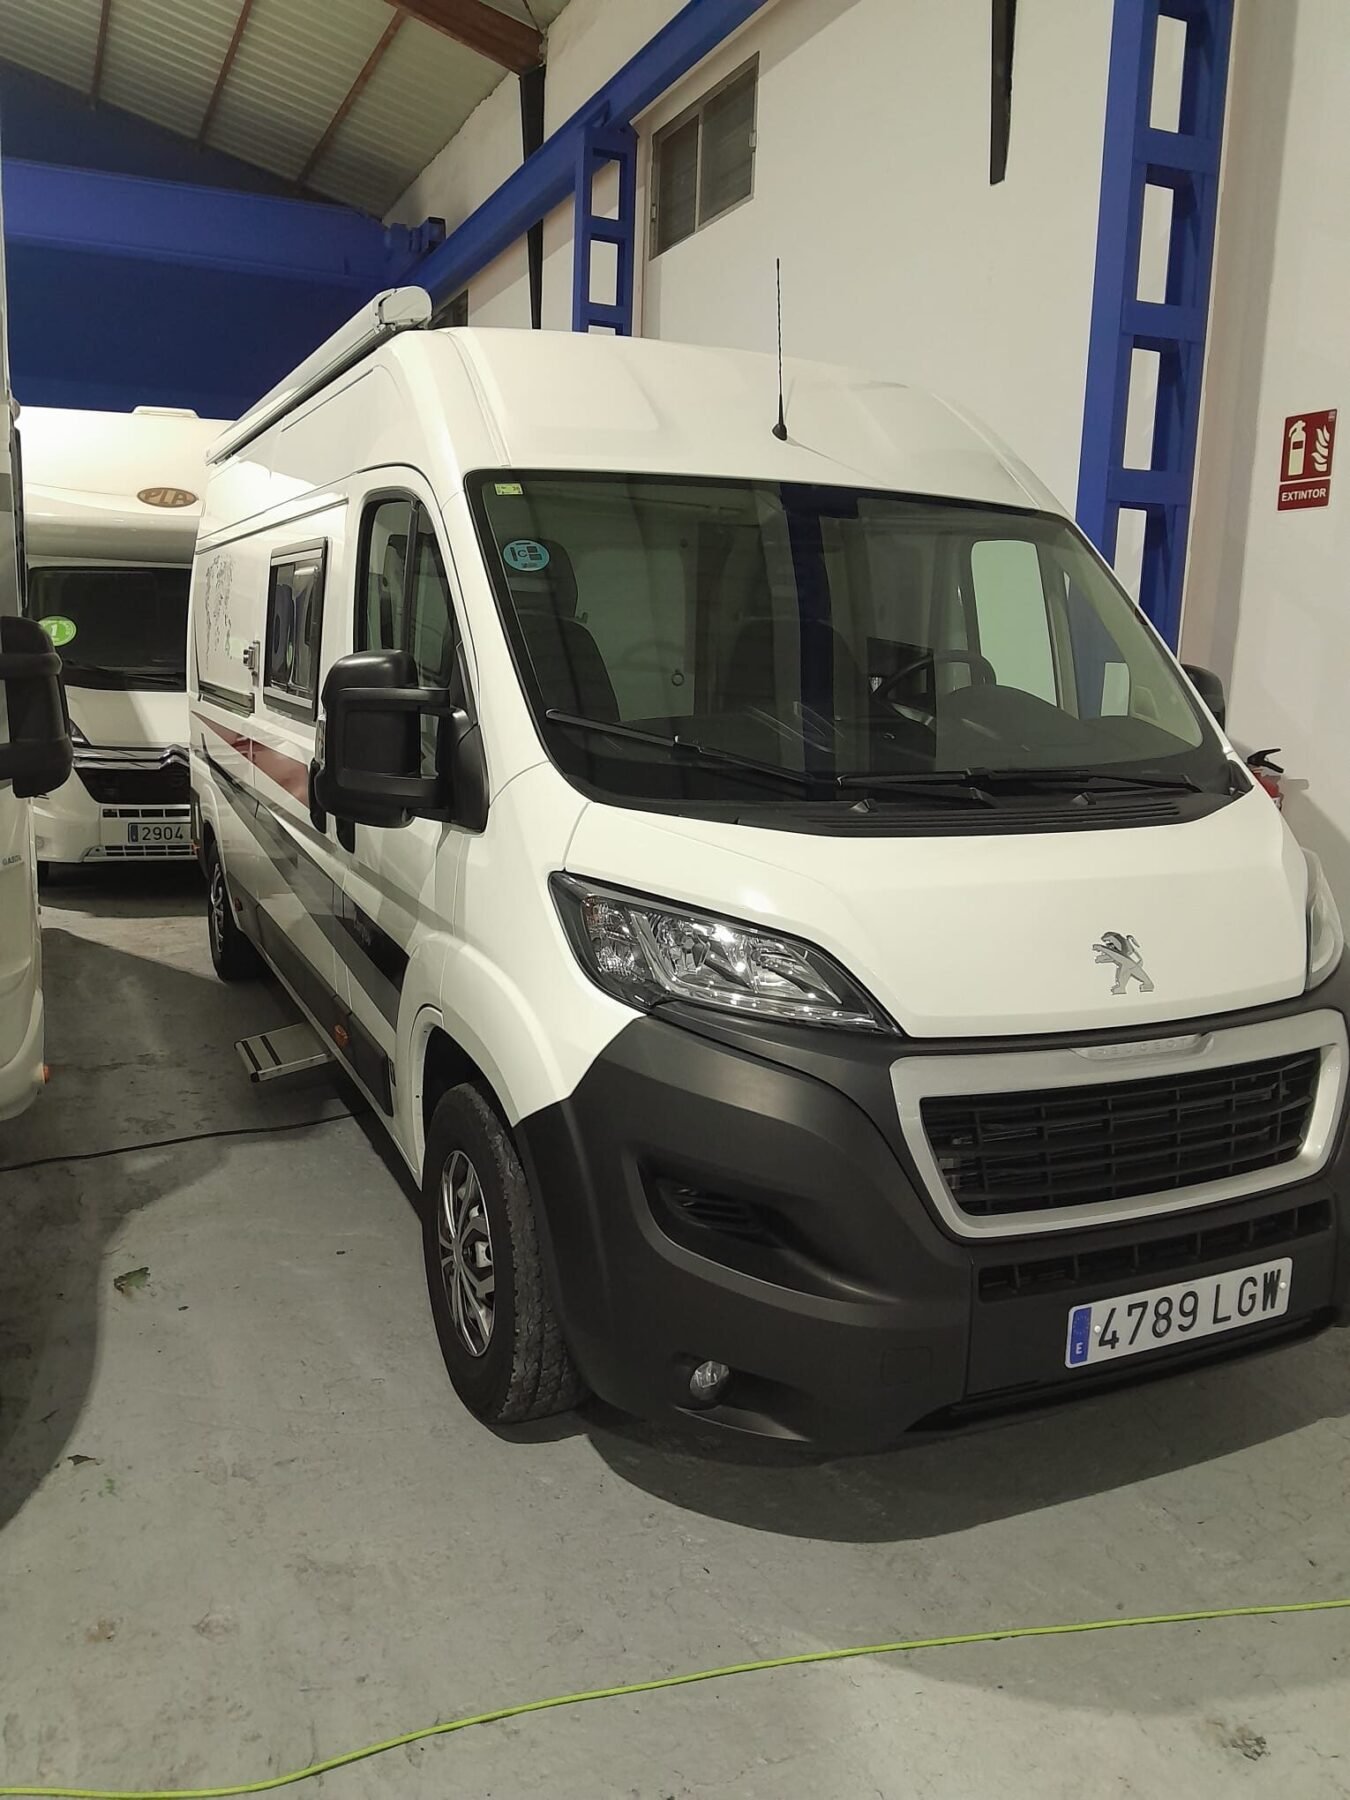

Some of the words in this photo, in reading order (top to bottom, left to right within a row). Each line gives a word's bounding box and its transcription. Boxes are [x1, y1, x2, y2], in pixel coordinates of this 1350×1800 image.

[1281, 488, 1327, 502] EXTINTOR
[142, 826, 183, 841] 2904
[1098, 1290, 1200, 1350] 4789
[1212, 1269, 1282, 1325] LGW
[1075, 1342, 1083, 1355] E
